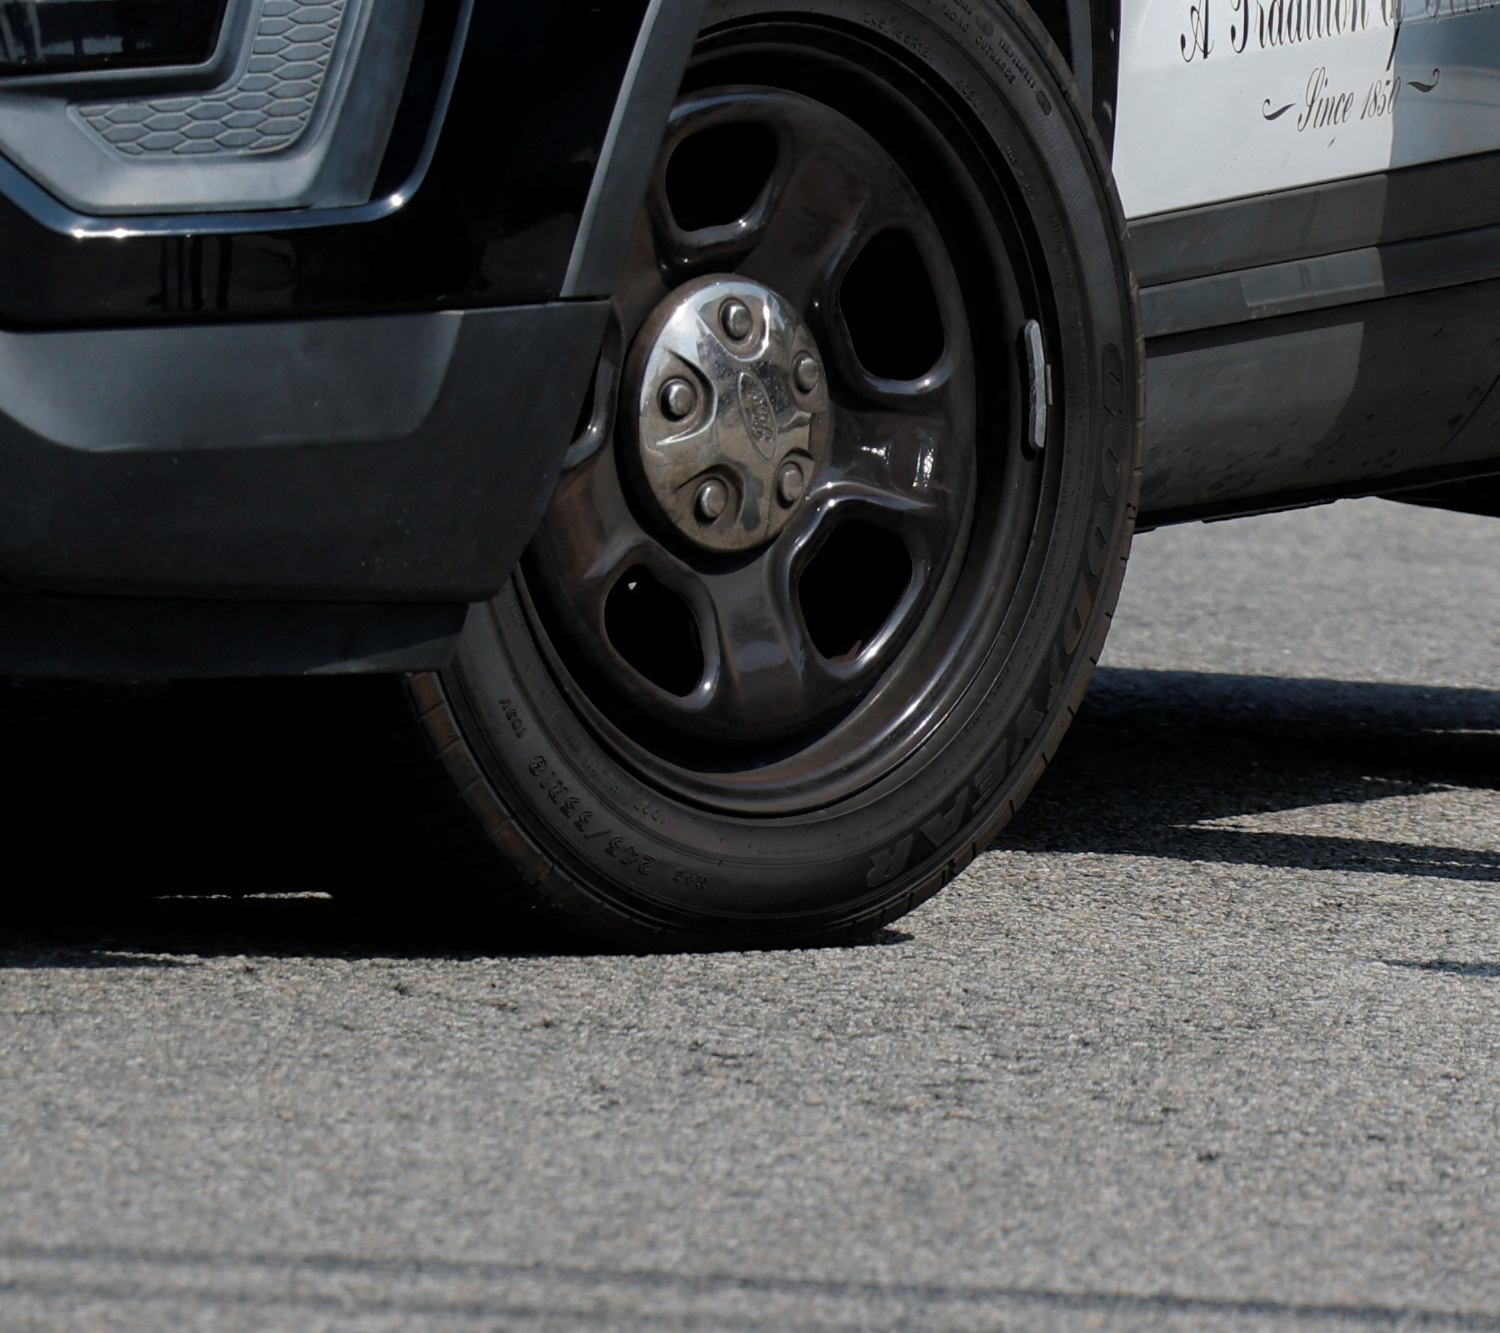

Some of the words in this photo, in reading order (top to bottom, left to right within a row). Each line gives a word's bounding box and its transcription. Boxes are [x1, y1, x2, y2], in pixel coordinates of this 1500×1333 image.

[1297, 66, 1355, 134] Since
[1359, 75, 1402, 122] 1850
[865, 341, 1124, 890] GOODYEAR
